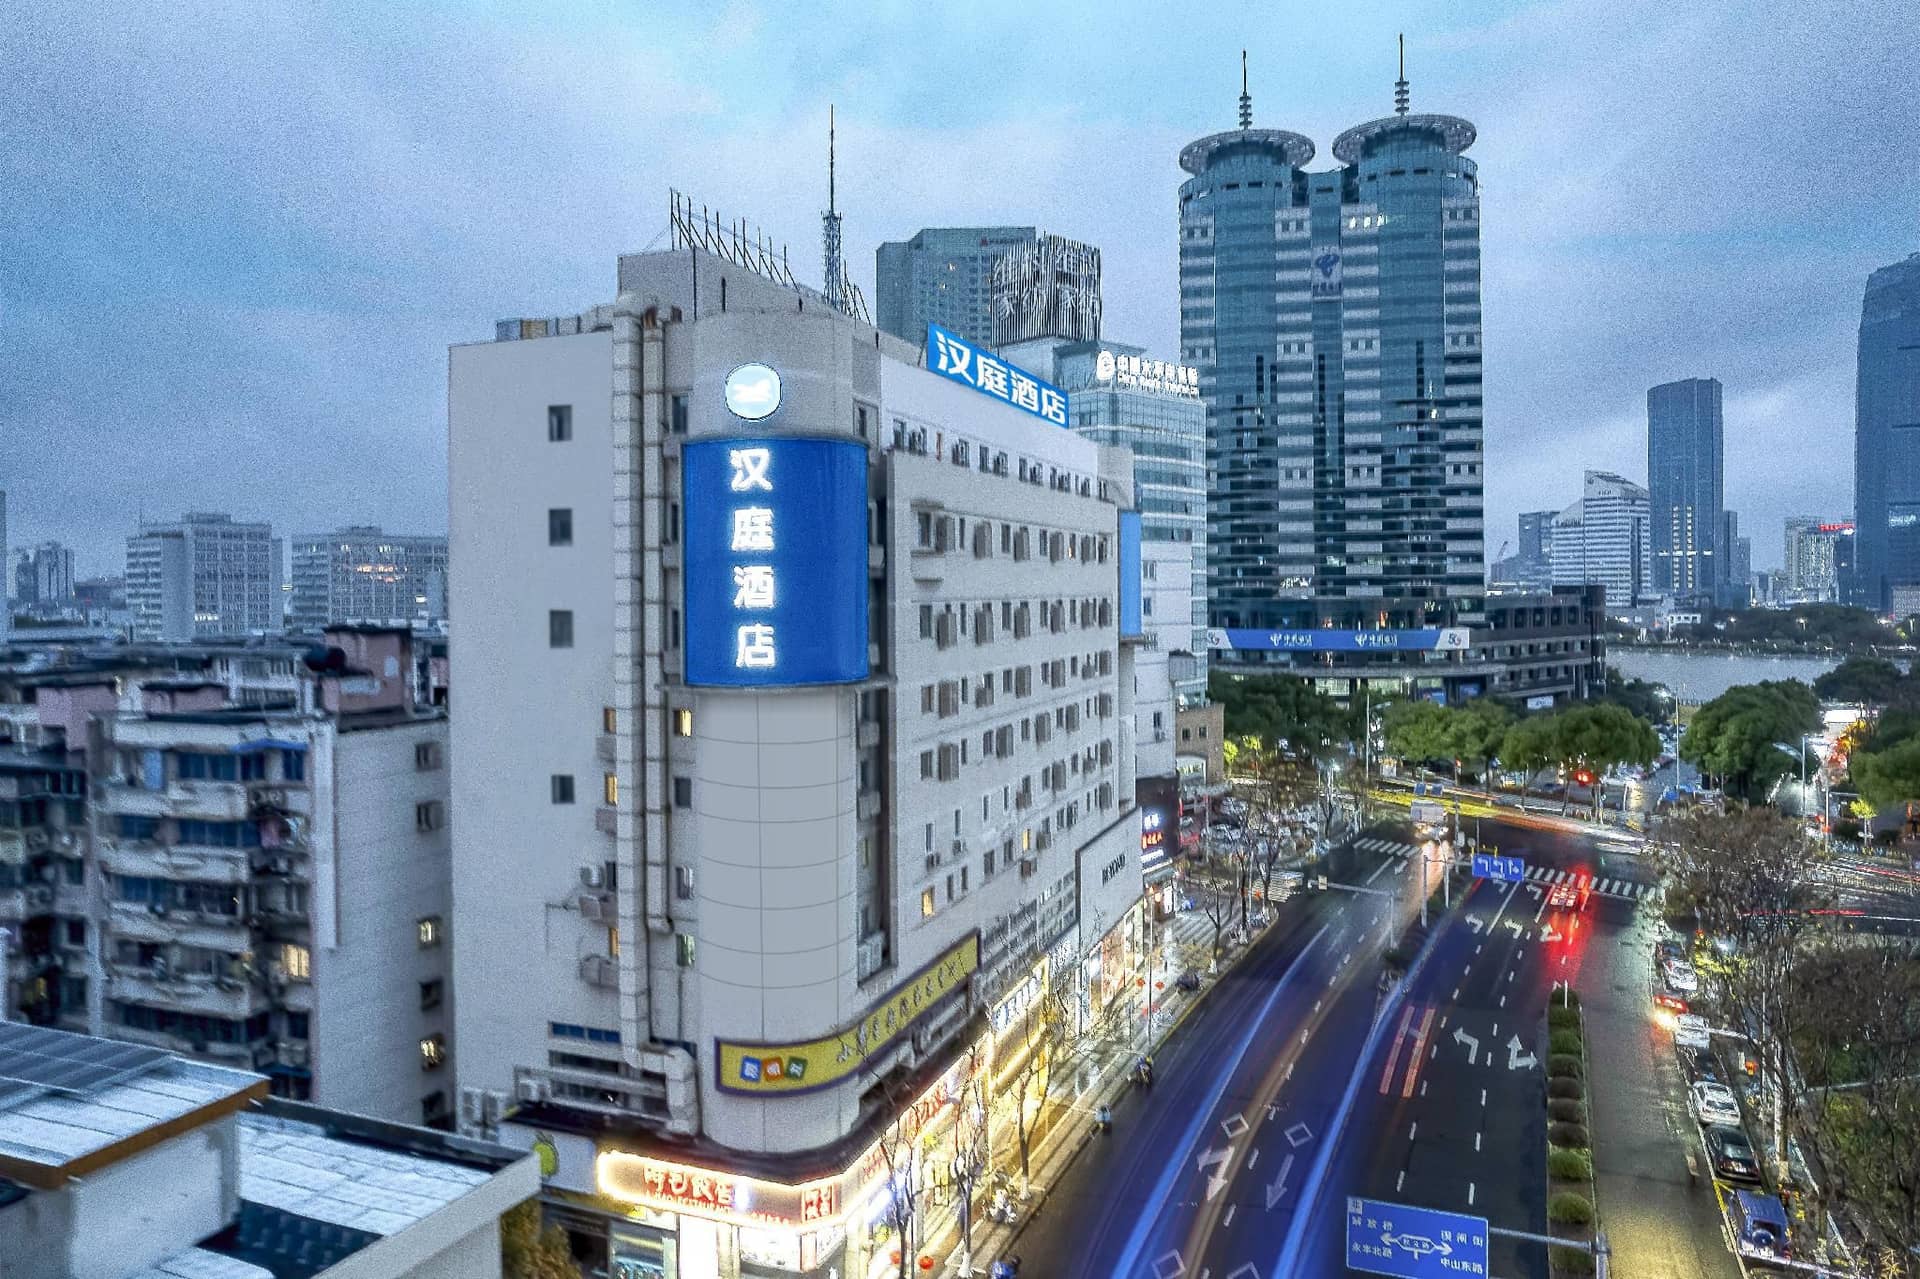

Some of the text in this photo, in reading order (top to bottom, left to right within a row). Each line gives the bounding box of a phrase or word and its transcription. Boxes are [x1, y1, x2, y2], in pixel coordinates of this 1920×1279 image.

[935, 330, 1066, 425] 汉庭酒店
[730, 447, 776, 669] 汉庭酒店
[1440, 1257, 1484, 1276] 中山东路
